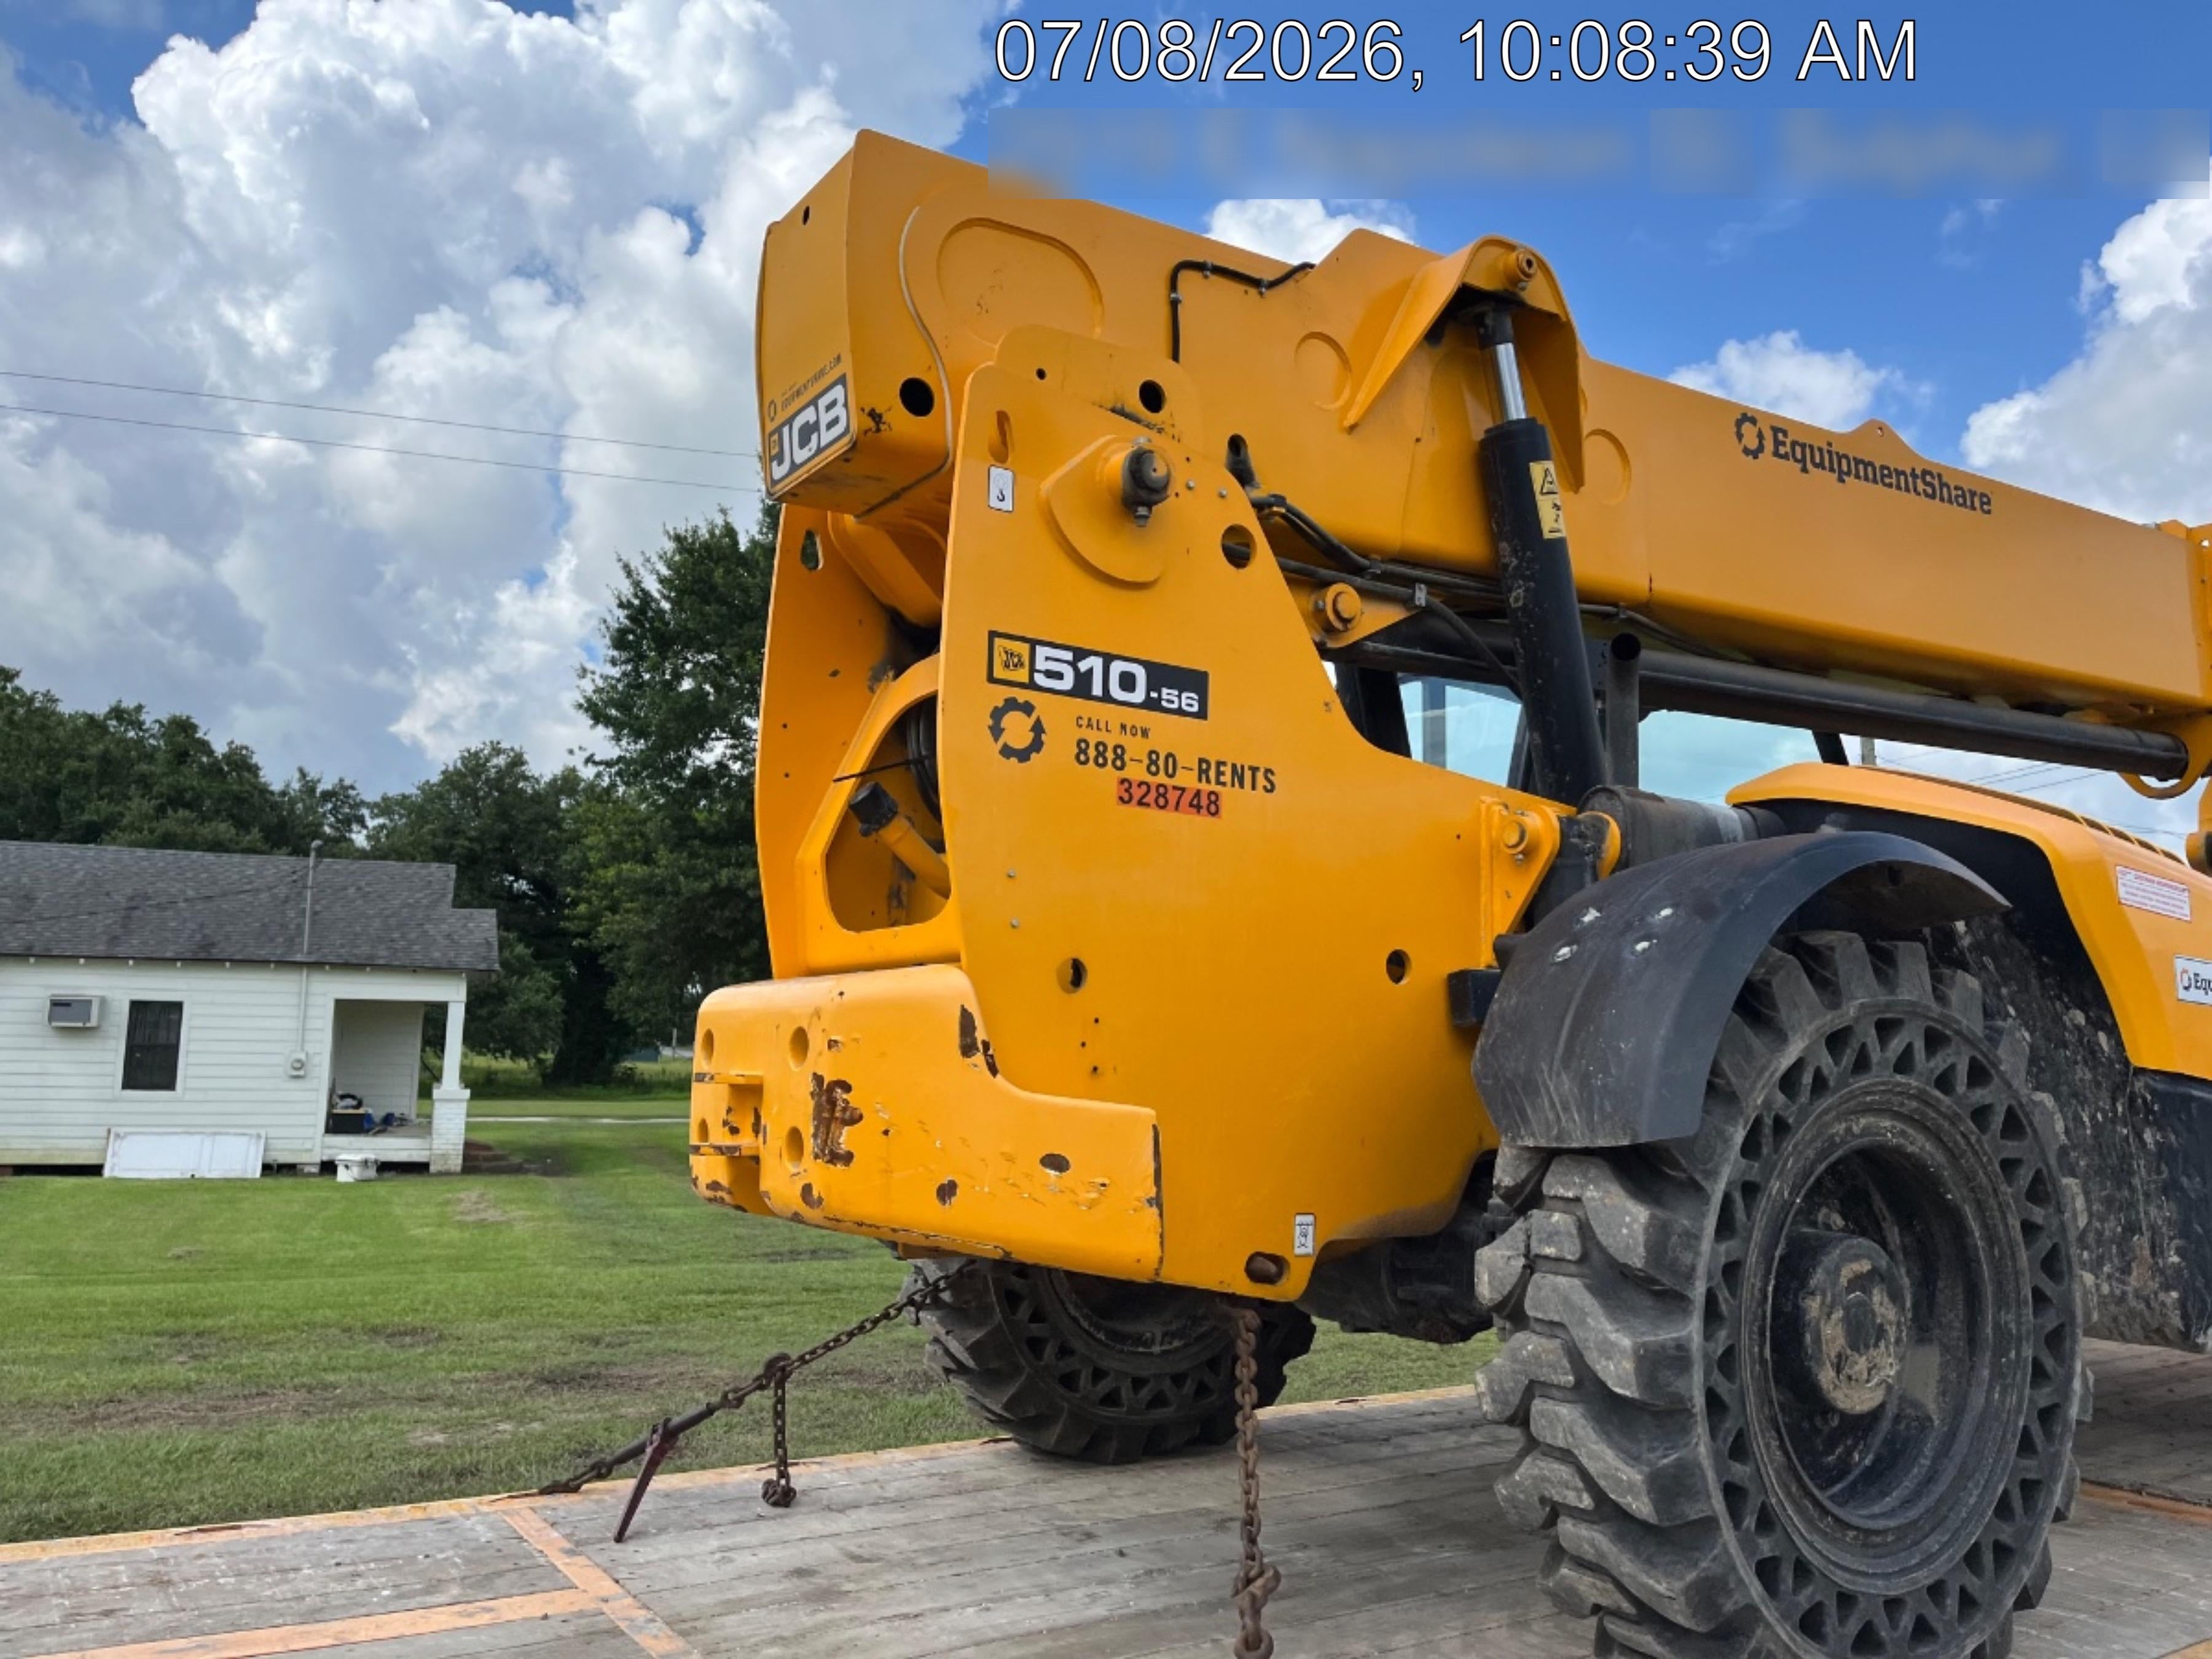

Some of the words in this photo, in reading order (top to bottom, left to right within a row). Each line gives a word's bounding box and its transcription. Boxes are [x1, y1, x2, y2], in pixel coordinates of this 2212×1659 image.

[772, 383, 847, 480] JCB
[1770, 425, 1992, 515] EquipmentShare
[1076, 716, 1112, 733] CALL
[1120, 722, 1150, 739] NOW
[1075, 738, 1276, 793] 888-80-RENTS
[1118, 777, 1220, 817] 328748
